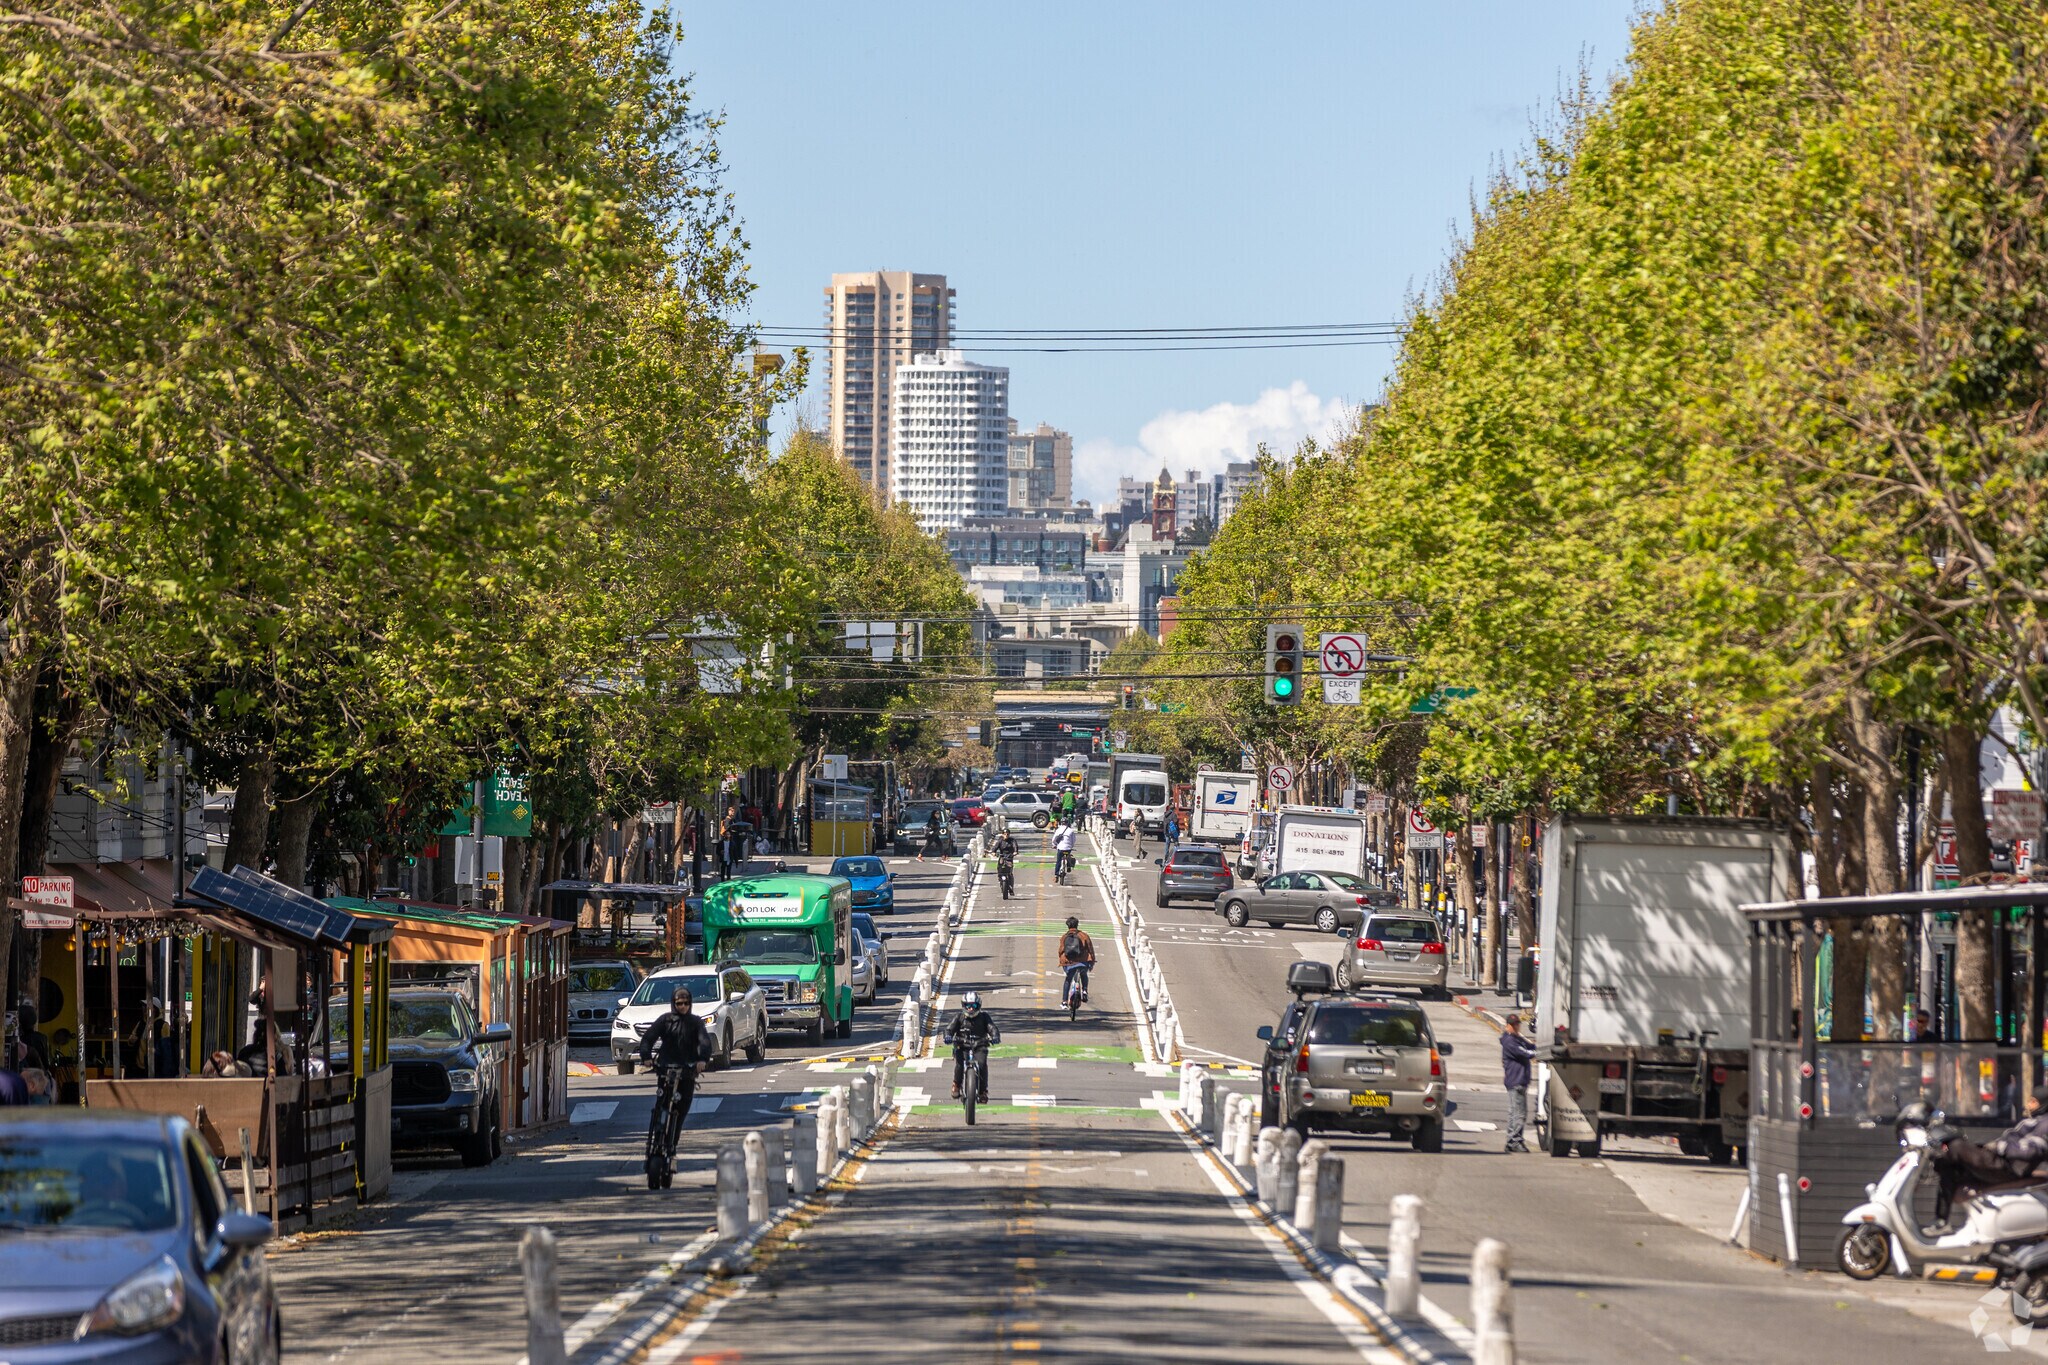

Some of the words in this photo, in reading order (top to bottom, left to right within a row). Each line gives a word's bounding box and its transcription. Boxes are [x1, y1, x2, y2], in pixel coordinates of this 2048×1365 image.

[1328, 680, 1357, 688] EXCEPT
[1293, 831, 1349, 841] DONATIONS
[24, 879, 38, 892] NO
[39, 882, 71, 892] PARKING
[53, 896, 68, 905] 8AM
[1158, 927, 1277, 938] CLEAR
[1171, 935, 1265, 944] KEEP
